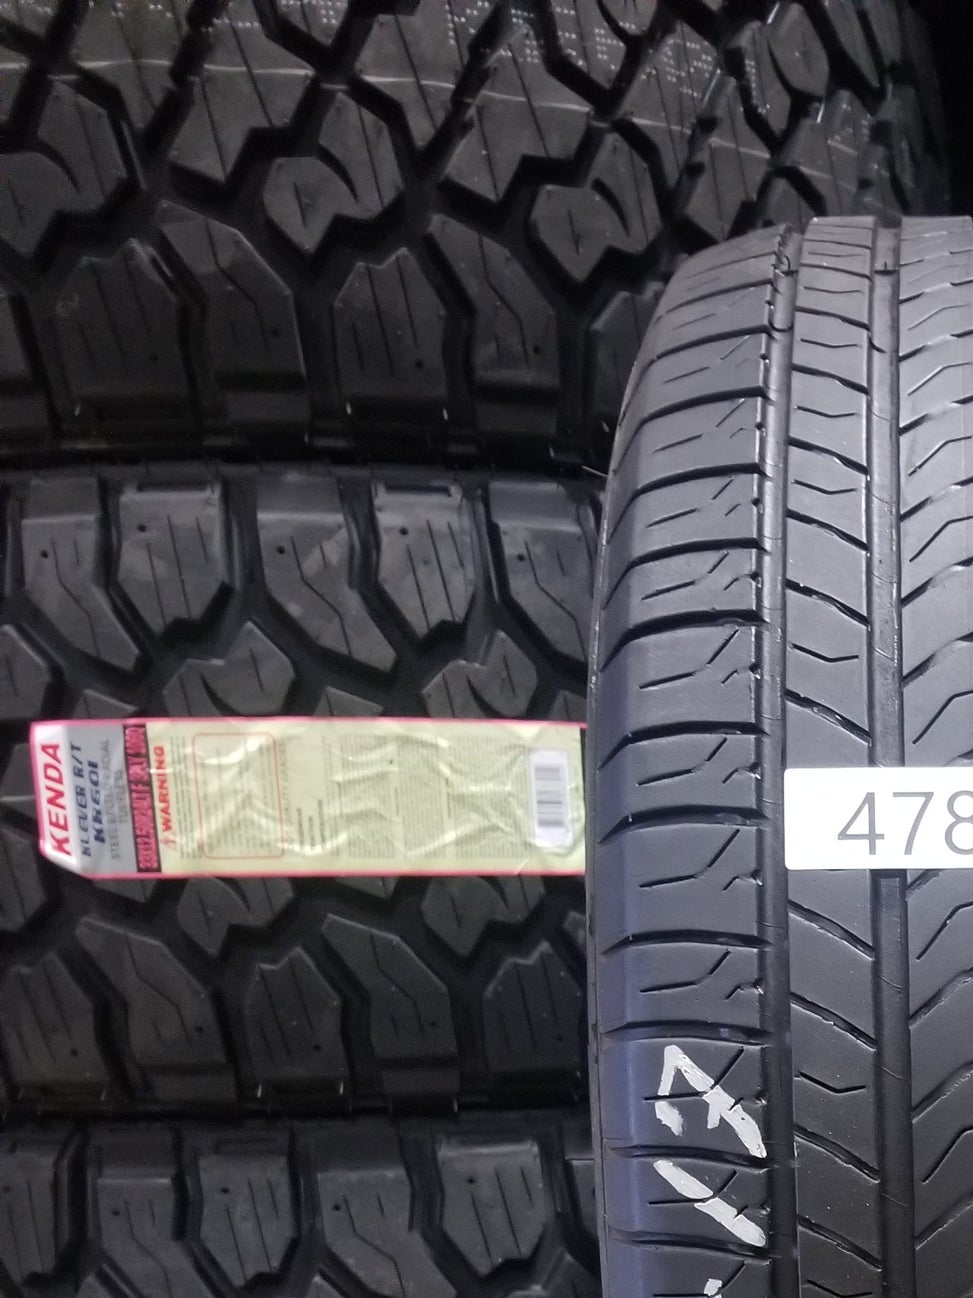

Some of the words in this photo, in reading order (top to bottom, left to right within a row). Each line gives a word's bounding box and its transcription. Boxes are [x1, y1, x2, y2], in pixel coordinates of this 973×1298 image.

[70, 741, 85, 778] R/T
[153, 745, 172, 832] WARNING
[41, 743, 72, 857] KENDA
[75, 785, 92, 857] KLEVER
